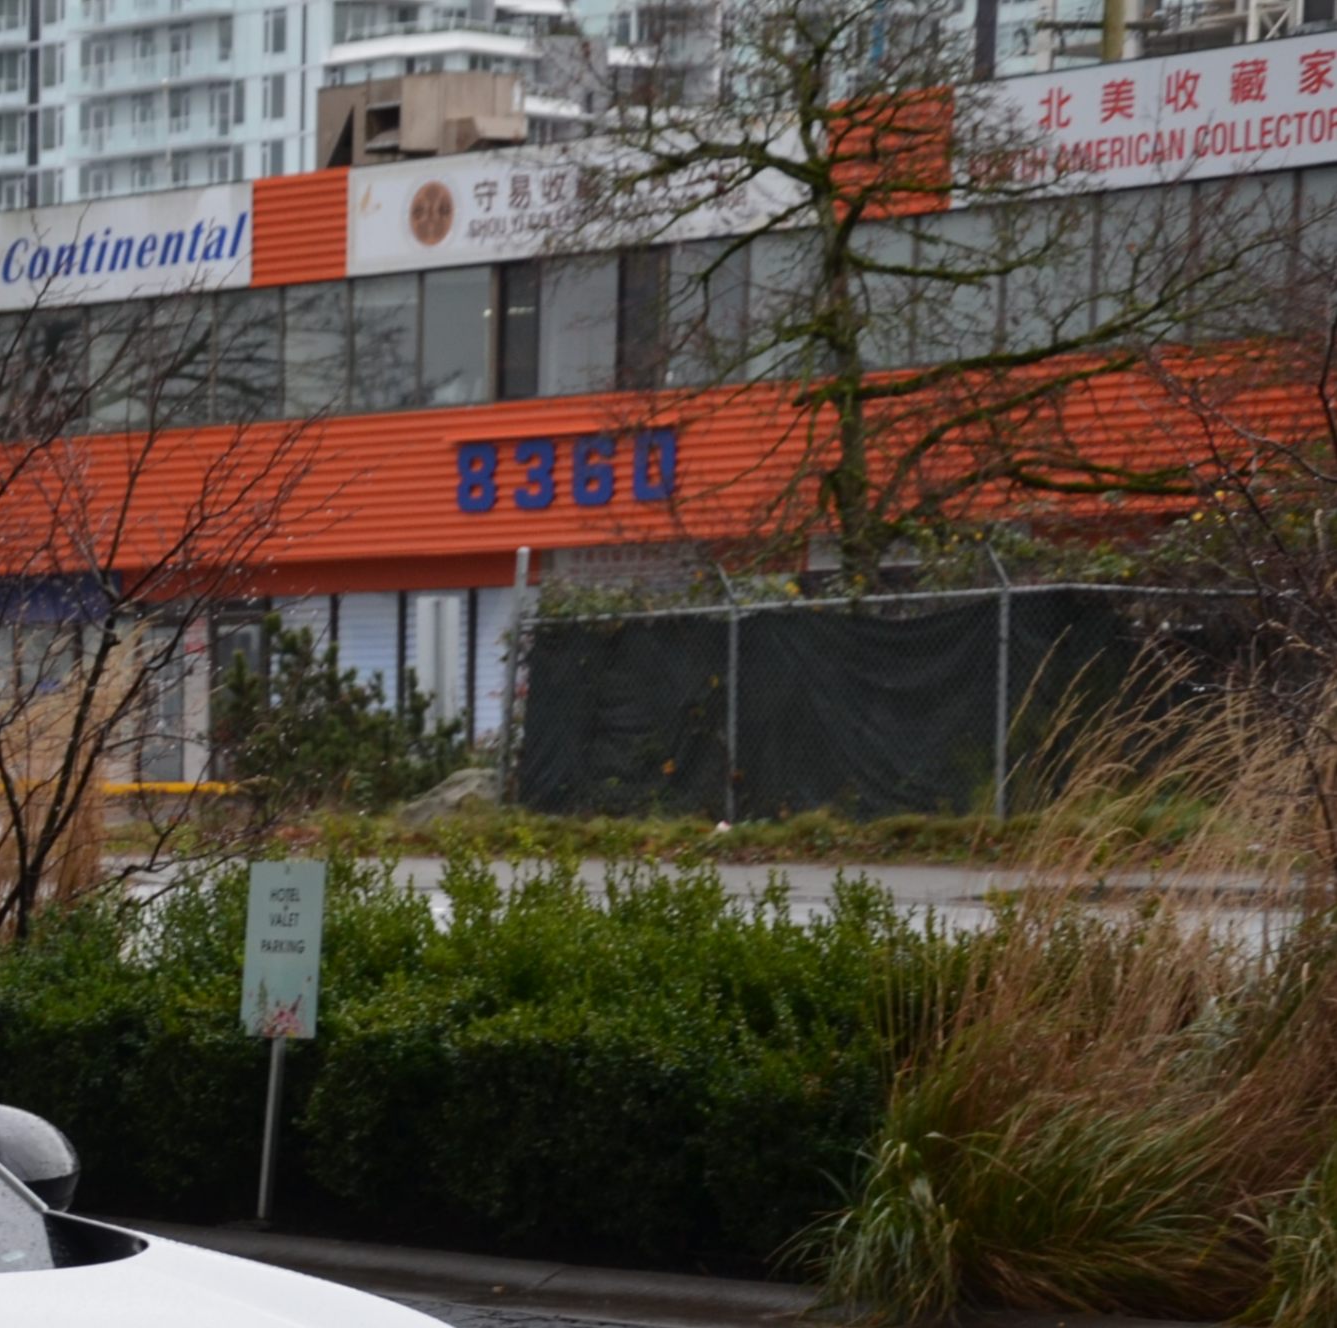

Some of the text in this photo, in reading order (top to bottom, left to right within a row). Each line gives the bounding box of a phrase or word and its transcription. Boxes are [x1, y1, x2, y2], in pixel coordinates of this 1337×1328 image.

[1039, 48, 1336, 131] 北美收藏家
[1056, 128, 1185, 176] AMERICAN
[2, 211, 249, 284] Continental
[457, 429, 676, 513] 8360
[269, 887, 301, 902] HOTEL
[269, 912, 300, 927] VALET
[261, 939, 305, 954] PARKING
